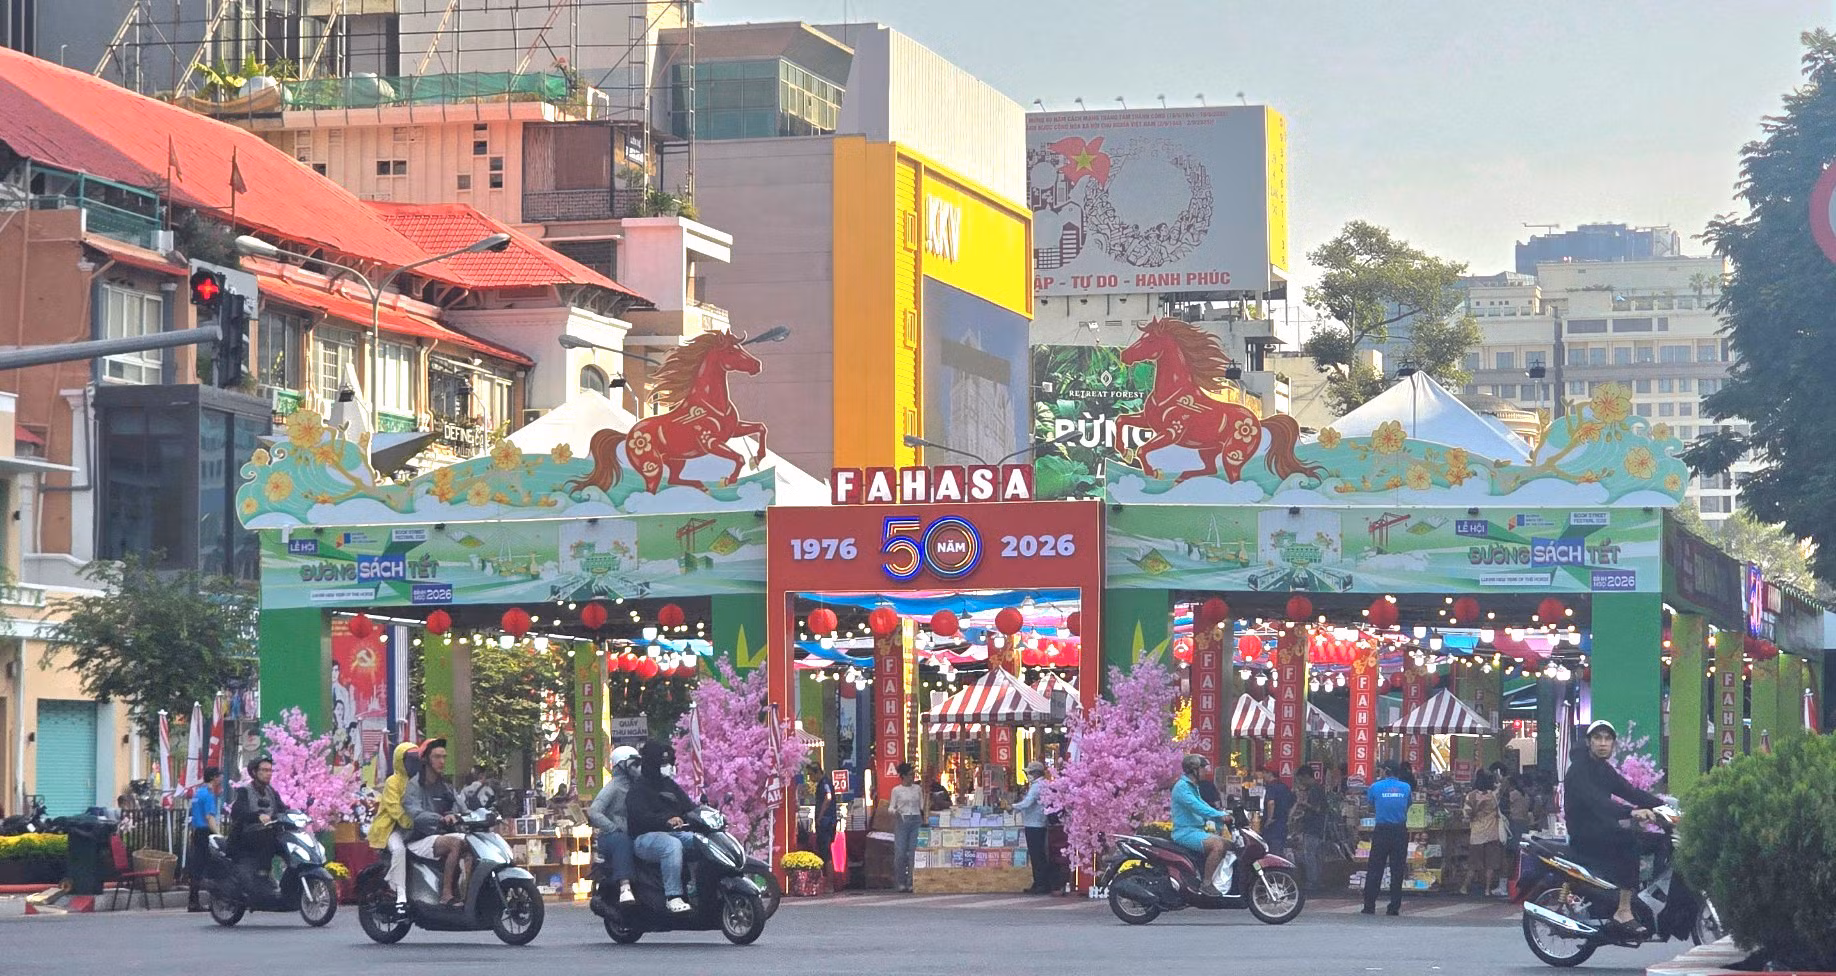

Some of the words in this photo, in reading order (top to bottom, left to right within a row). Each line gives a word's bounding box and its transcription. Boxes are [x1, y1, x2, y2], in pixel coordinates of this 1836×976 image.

[1034, 275, 1054, 292] ẬP
[1071, 275, 1093, 291] TỰ
[1096, 275, 1118, 288] DO
[1135, 273, 1181, 290] HẠNH
[1186, 269, 1231, 285] PHÚC
[1069, 390, 1108, 399] RETREAT
[1110, 390, 1144, 399] FOREST
[837, 468, 1030, 502] FAHASA
[1457, 523, 1469, 533] LỄ
[1470, 524, 1485, 534] HỘI
[791, 538, 858, 561] 1976
[881, 515, 985, 581] 50
[1000, 534, 1076, 558] 2026
[937, 540, 966, 553] NĂM
[1533, 540, 1582, 563] SÁCH
[1586, 537, 1621, 564] TẾT
[359, 557, 404, 578] SÁCH
[408, 552, 440, 578] TẾT
[427, 589, 452, 600] 2026
[1607, 576, 1635, 588] 2026
[885, 659, 898, 775] FAHASA
[1281, 668, 1293, 775] FAHASA
[1356, 677, 1367, 776] FAHASA
[1723, 674, 1734, 760] FAHAS
[583, 684, 595, 788] FAHASA
